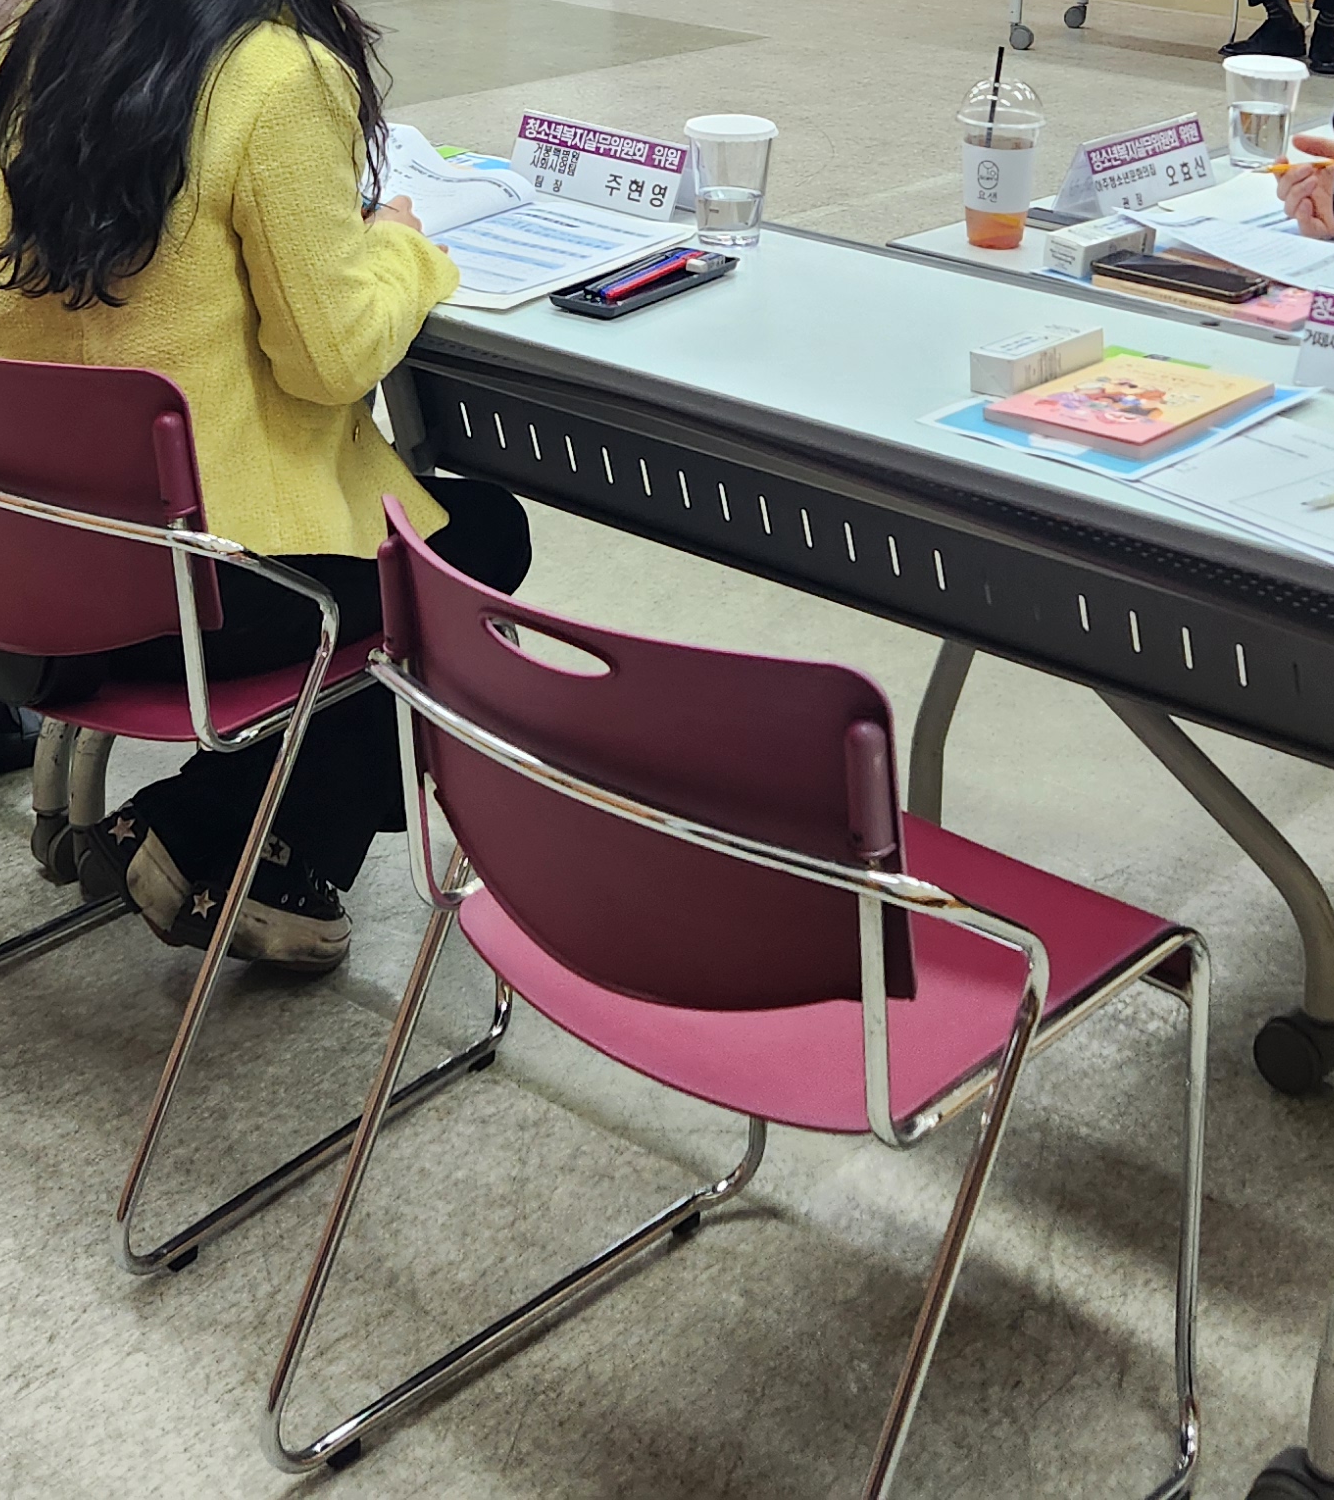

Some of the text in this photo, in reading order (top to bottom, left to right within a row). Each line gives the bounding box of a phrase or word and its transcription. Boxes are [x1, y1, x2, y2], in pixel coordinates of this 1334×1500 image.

[525, 118, 682, 171] 청소년복지실무위원회 위원
[530, 155, 577, 177] 사회사업팀
[1089, 122, 1200, 172] 청소년복지실무위원회 위원
